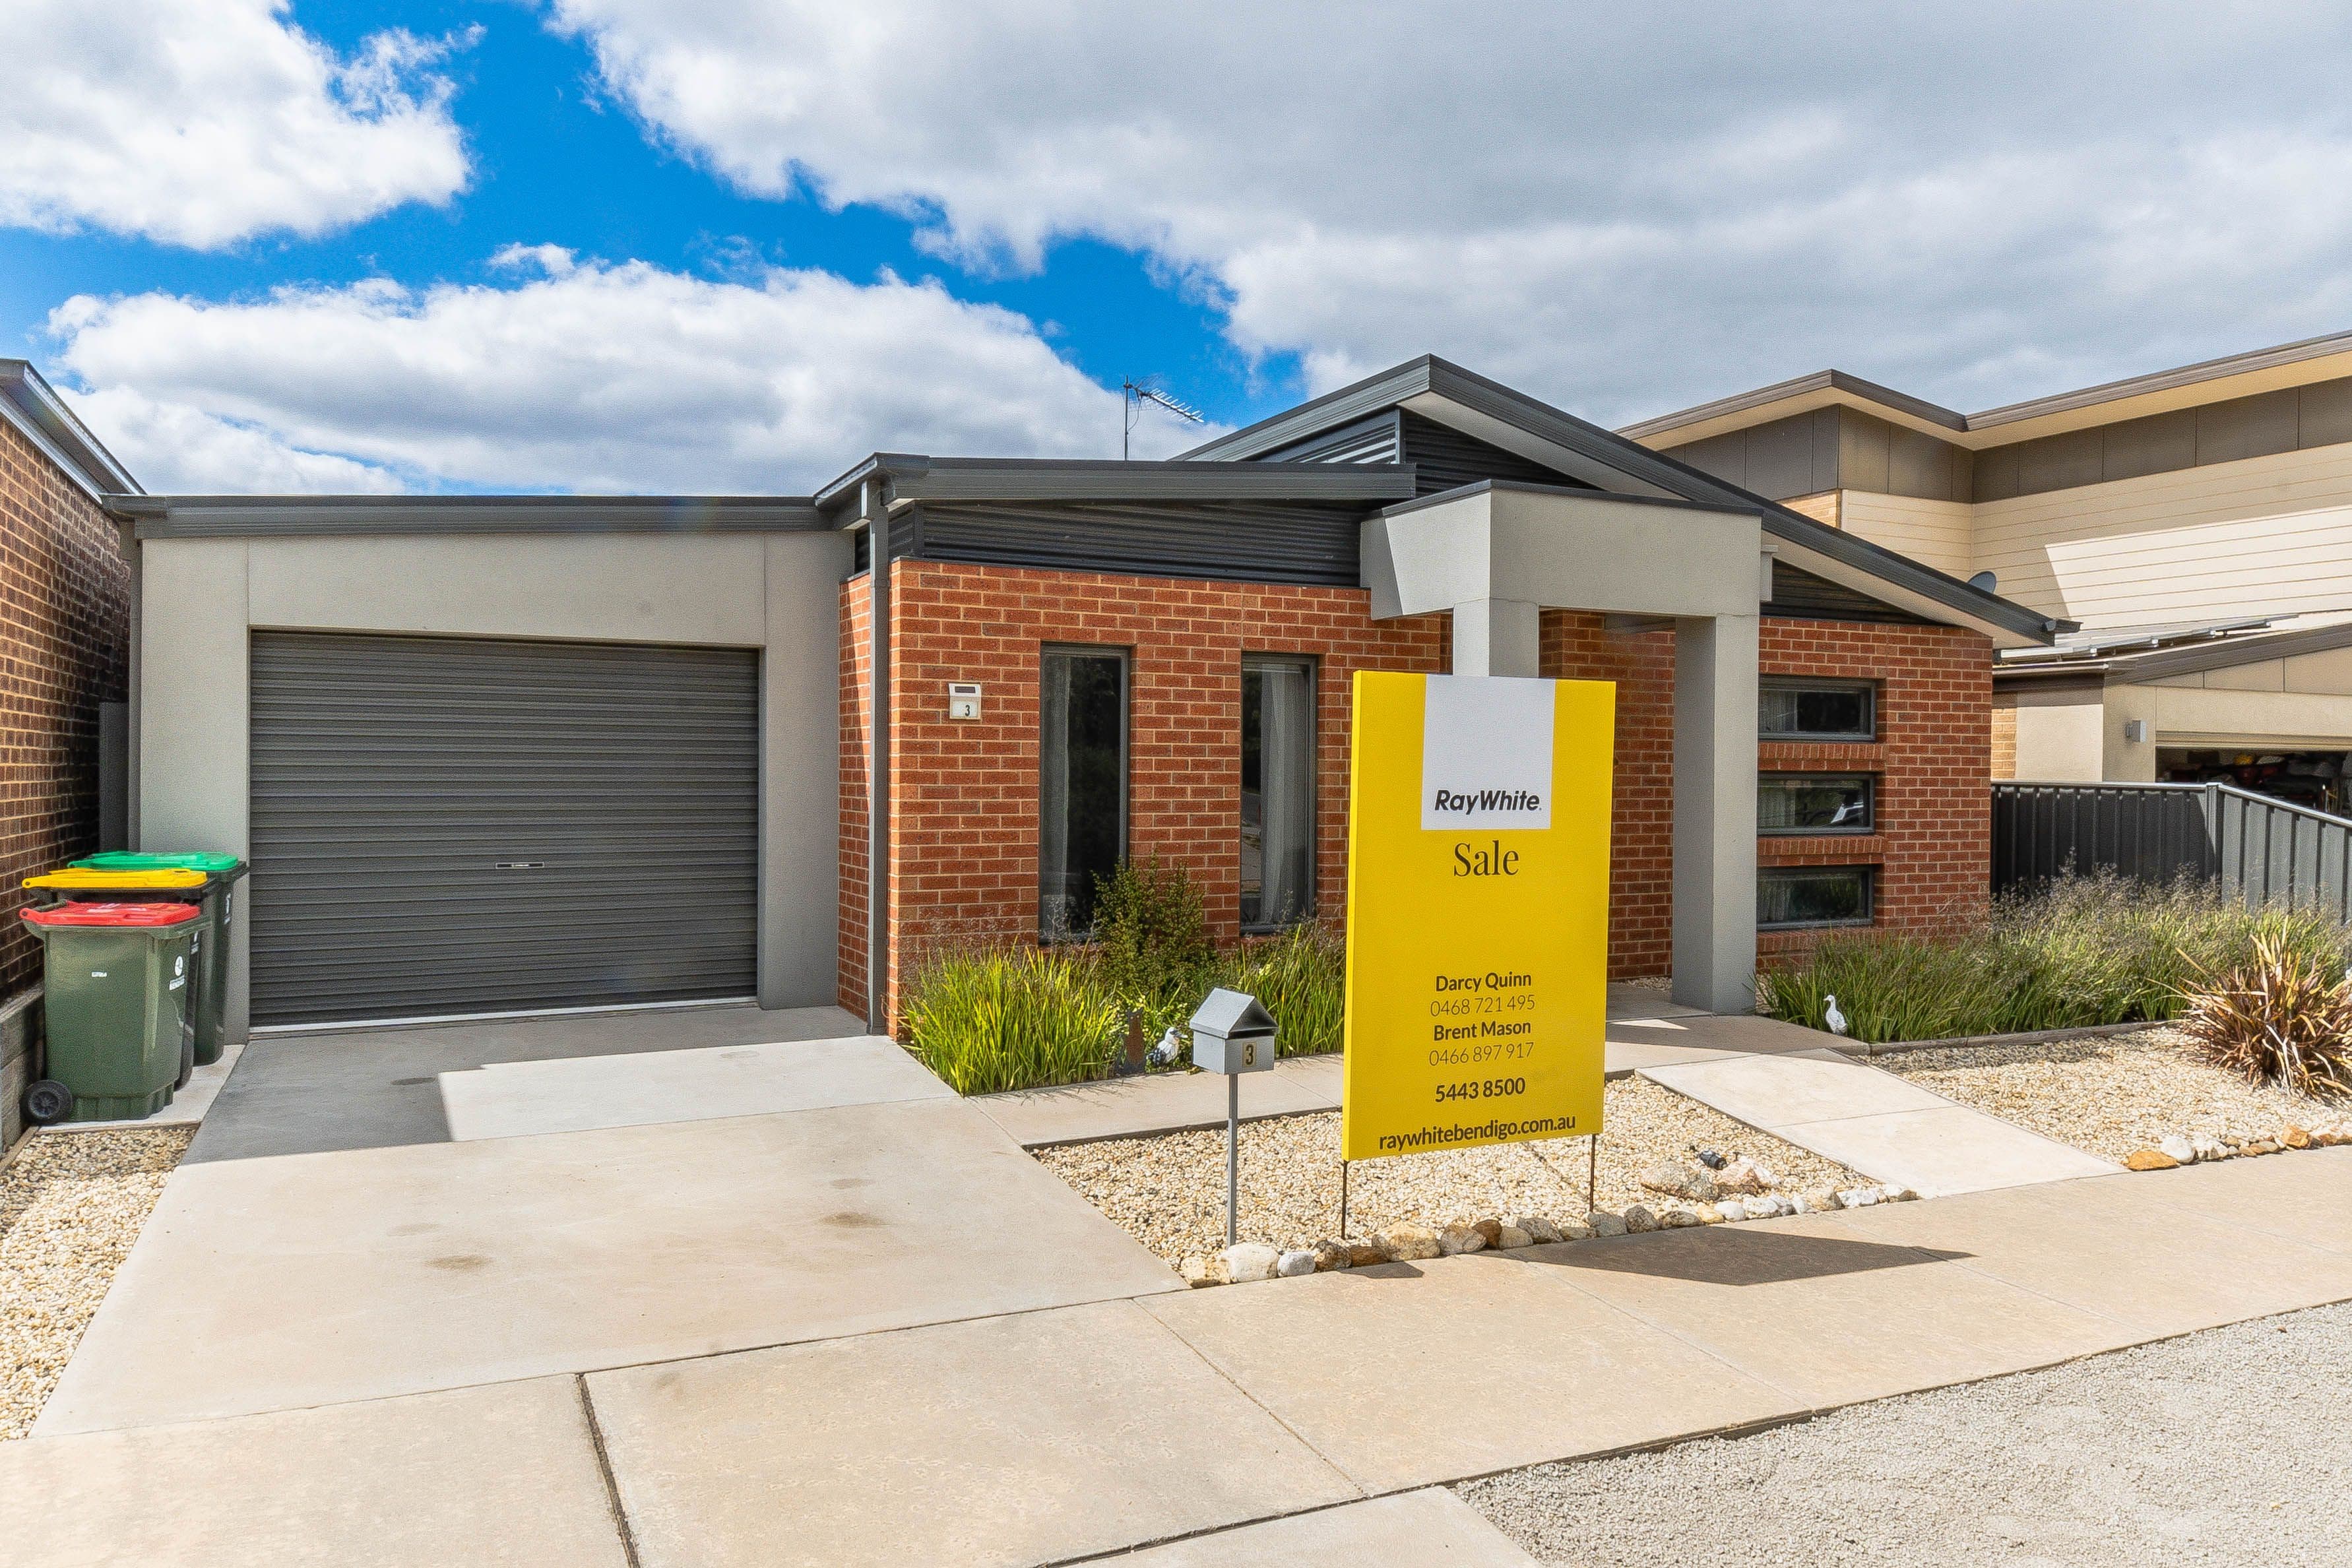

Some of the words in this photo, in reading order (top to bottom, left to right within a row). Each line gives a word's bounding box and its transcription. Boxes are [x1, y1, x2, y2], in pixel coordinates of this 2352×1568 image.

[965, 705, 970, 716] 3
[1453, 840, 1519, 877] Sale
[1436, 975, 1482, 993] Darcy
[1485, 971, 1531, 991] Quinn
[1430, 998, 1471, 1017] 0468
[1475, 997, 1502, 1014] 721
[1507, 994, 1535, 1011] 495
[1434, 1023, 1477, 1042] Brent
[1481, 1020, 1531, 1038] Mason
[1245, 1044, 1254, 1065] 3
[1429, 1048, 1469, 1067] 0466
[1473, 1044, 1502, 1062] 897
[1506, 1042, 1534, 1059] 917
[1435, 1081, 1479, 1103] 5443
[1482, 1077, 1526, 1098] 8500
[1379, 1115, 1576, 1152] raywhitebendigo.com.au
